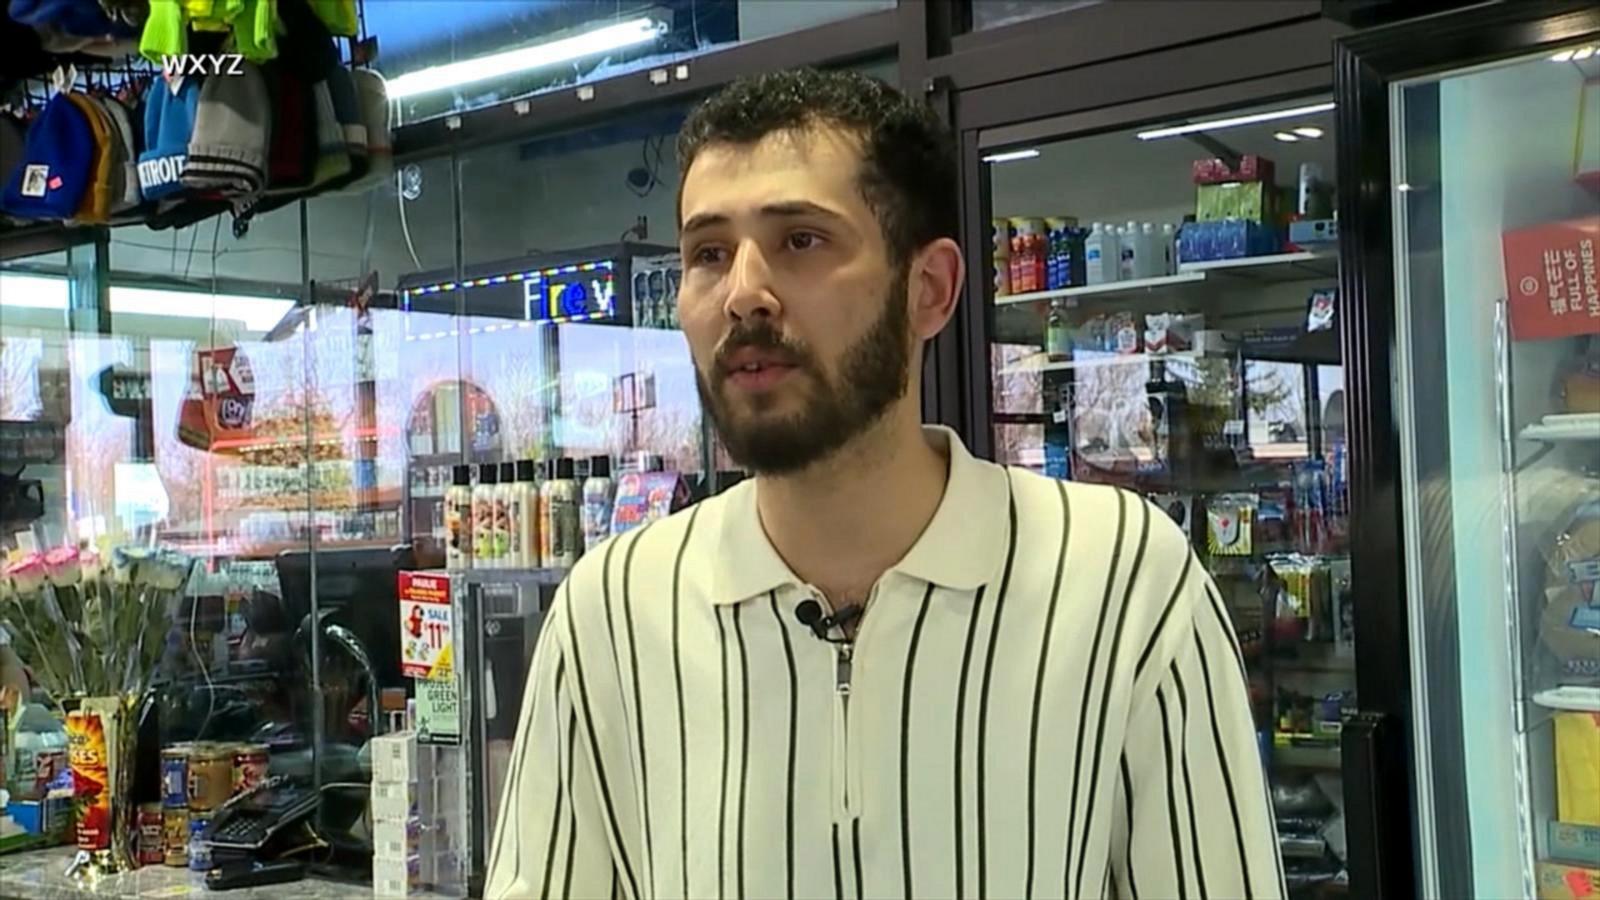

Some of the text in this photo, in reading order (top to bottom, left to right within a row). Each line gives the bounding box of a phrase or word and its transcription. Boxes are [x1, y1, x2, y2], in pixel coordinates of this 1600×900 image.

[1563, 250, 1584, 312] FULL OF
[428, 609, 448, 621] SALE
[427, 689, 457, 701] GREEN
[432, 702, 457, 713] LIGHT
